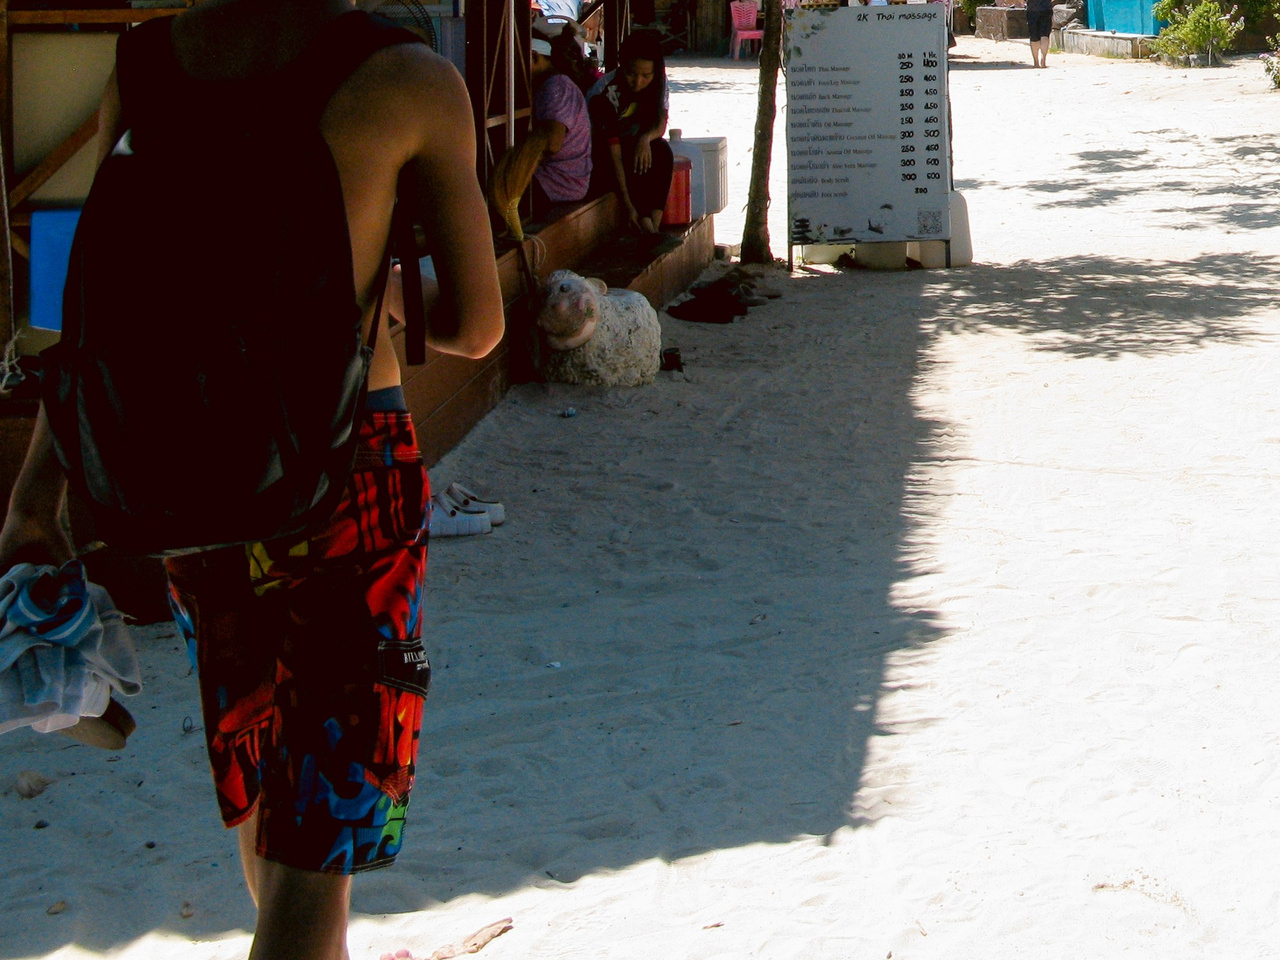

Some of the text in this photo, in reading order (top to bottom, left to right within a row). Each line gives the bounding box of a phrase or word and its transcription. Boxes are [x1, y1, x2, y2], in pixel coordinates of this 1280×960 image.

[857, 12, 937, 21] 2K Thai massage
[899, 61, 914, 69] 250
[923, 59, 938, 67] 400
[899, 75, 914, 83] 250
[899, 89, 914, 97] 250
[899, 103, 914, 111] 250
[924, 102, 939, 110] 450
[900, 116, 914, 124] 250
[900, 130, 914, 139] 300
[923, 129, 940, 138] 500
[901, 145, 915, 153] 250
[900, 159, 916, 167] 300
[926, 158, 940, 166] 600
[901, 173, 917, 181] 300
